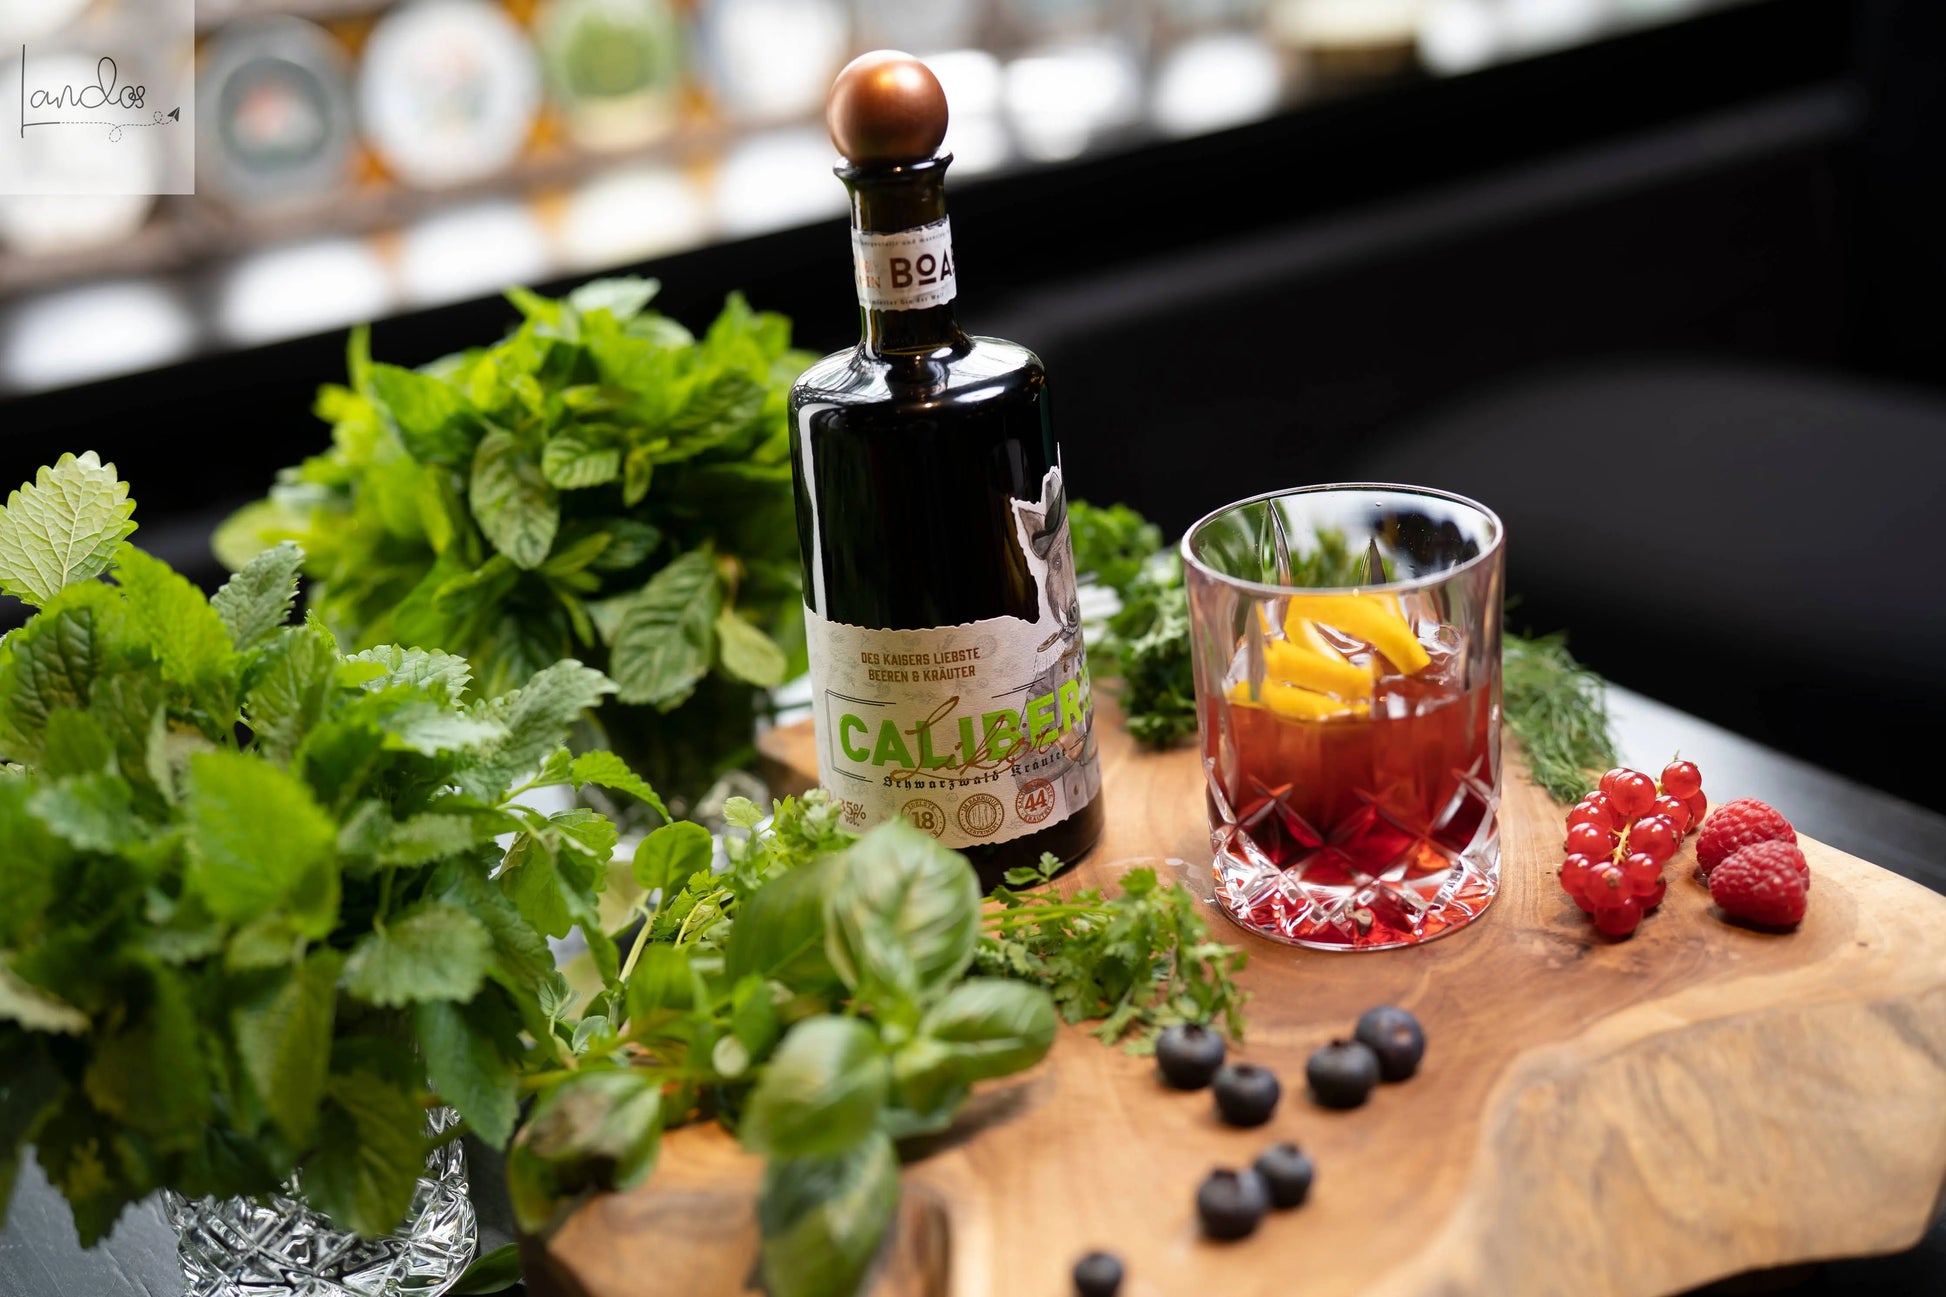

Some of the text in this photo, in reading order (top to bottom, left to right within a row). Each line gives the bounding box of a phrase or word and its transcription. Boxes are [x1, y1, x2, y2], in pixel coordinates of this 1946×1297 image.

[890, 248, 954, 288] BOA
[861, 647, 981, 666] DES KAISERS LIEBSTE
[868, 665, 976, 682] BEEREN & KRÄUTER
[839, 678, 1084, 769] CALIBER
[882, 770, 1000, 791] Schwarzwald
[1024, 789, 1048, 812] 44
[911, 811, 936, 830] 18
